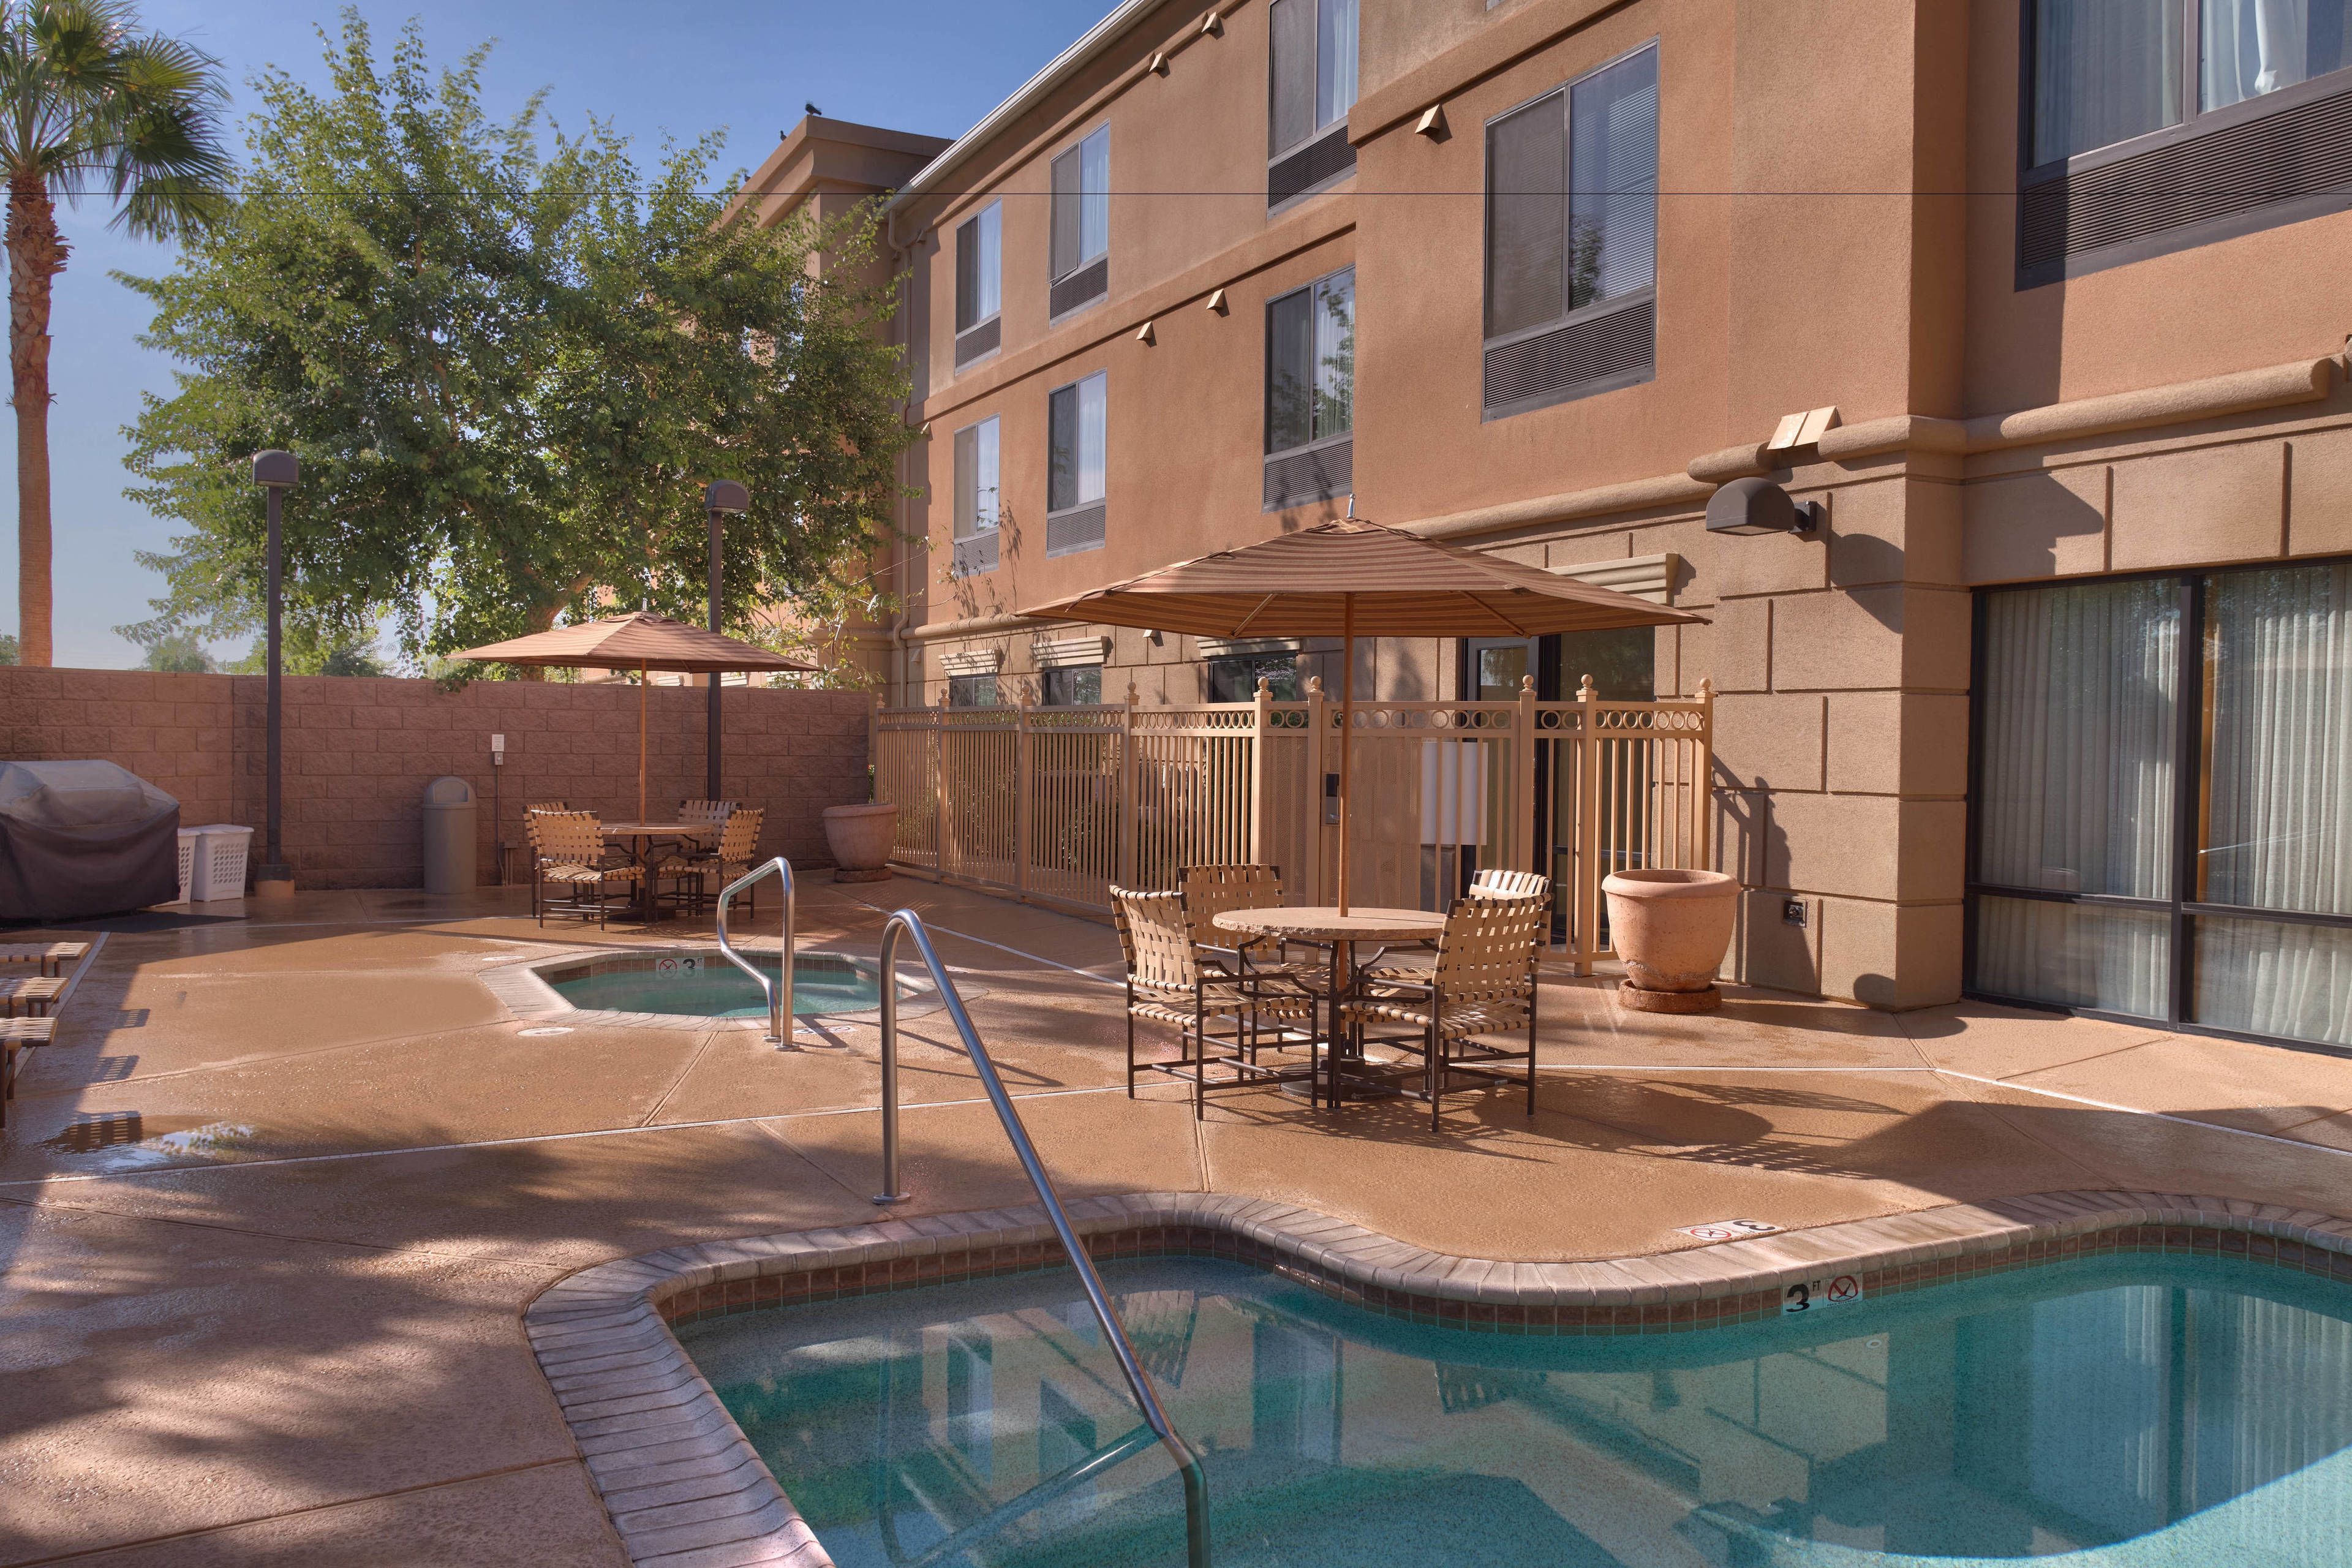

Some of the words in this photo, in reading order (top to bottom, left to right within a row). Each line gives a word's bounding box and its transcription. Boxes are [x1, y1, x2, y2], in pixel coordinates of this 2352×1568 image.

[1733, 1220, 1776, 1231] 3
[1785, 1283, 1811, 1313] 3
[1812, 1280, 1822, 1292] FT
